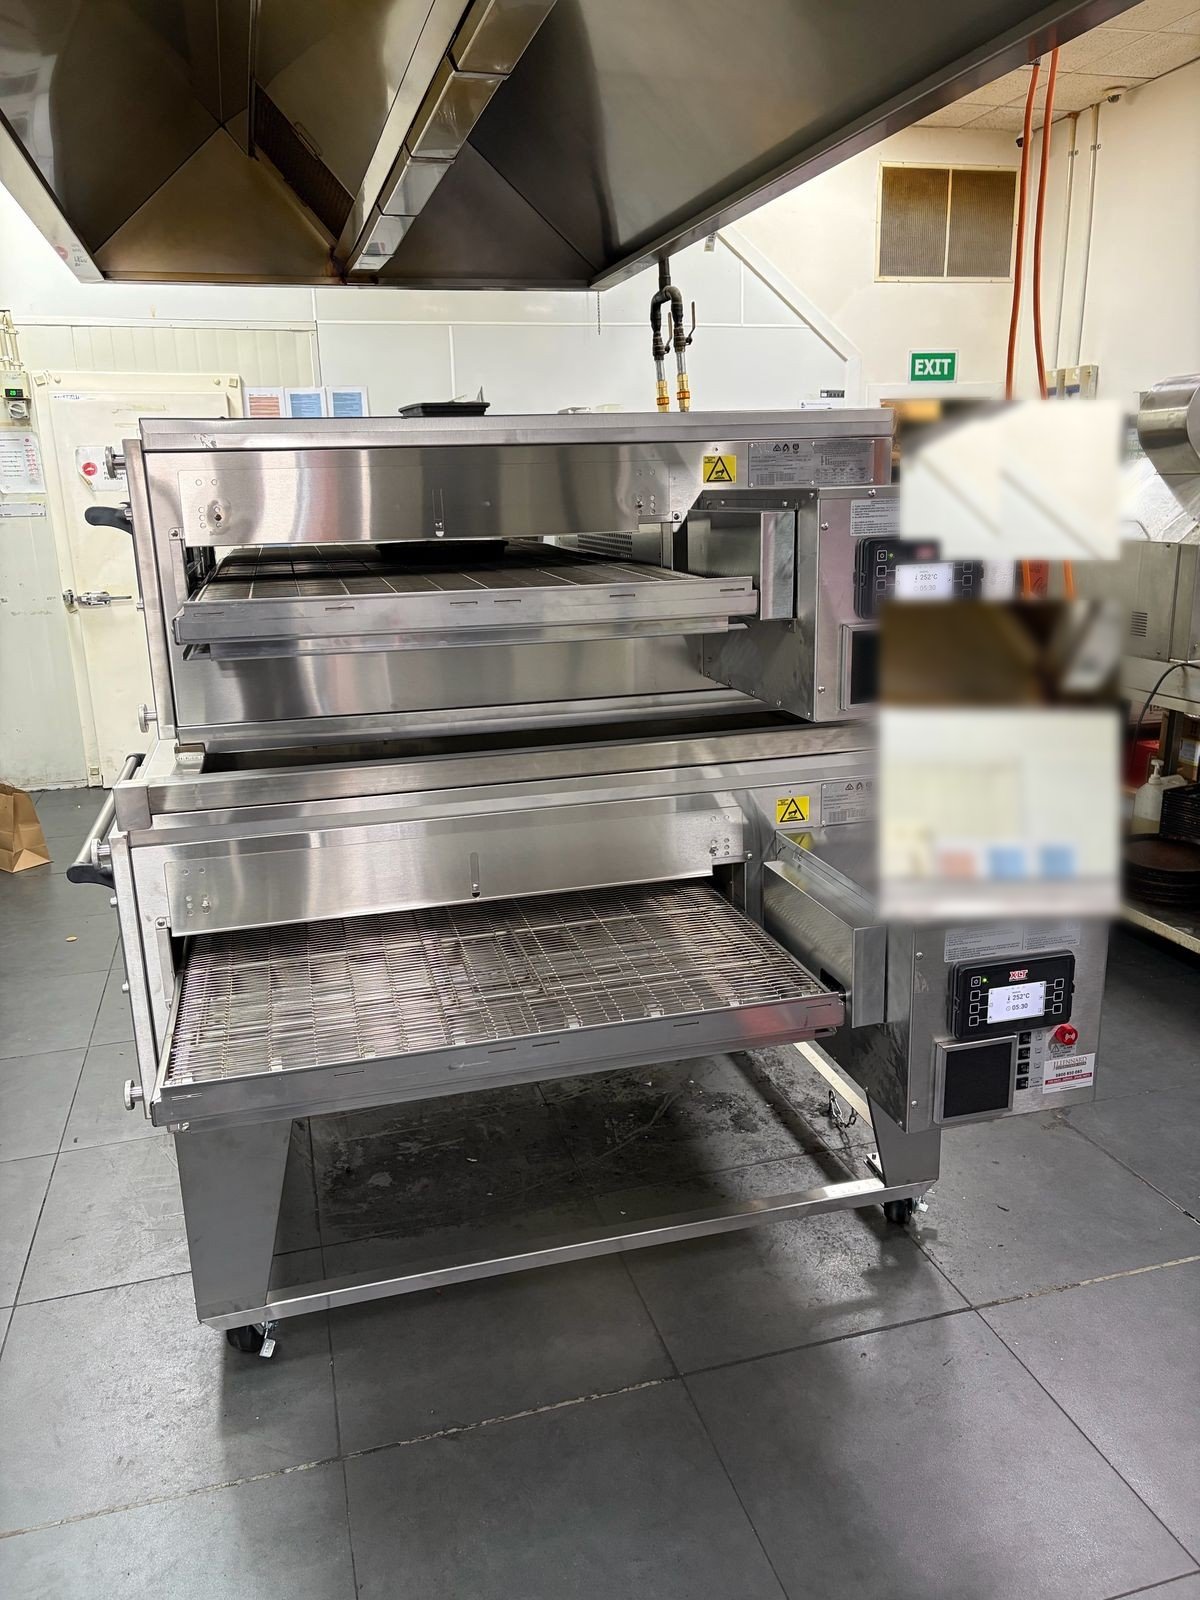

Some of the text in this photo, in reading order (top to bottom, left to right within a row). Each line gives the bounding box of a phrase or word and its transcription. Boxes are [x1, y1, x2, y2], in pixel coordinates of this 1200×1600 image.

[914, 359, 951, 376] EXIT
[919, 573, 938, 581] 252°C
[1012, 993, 1030, 1001] 252°C
[1011, 1003, 1029, 1011] 05:30
